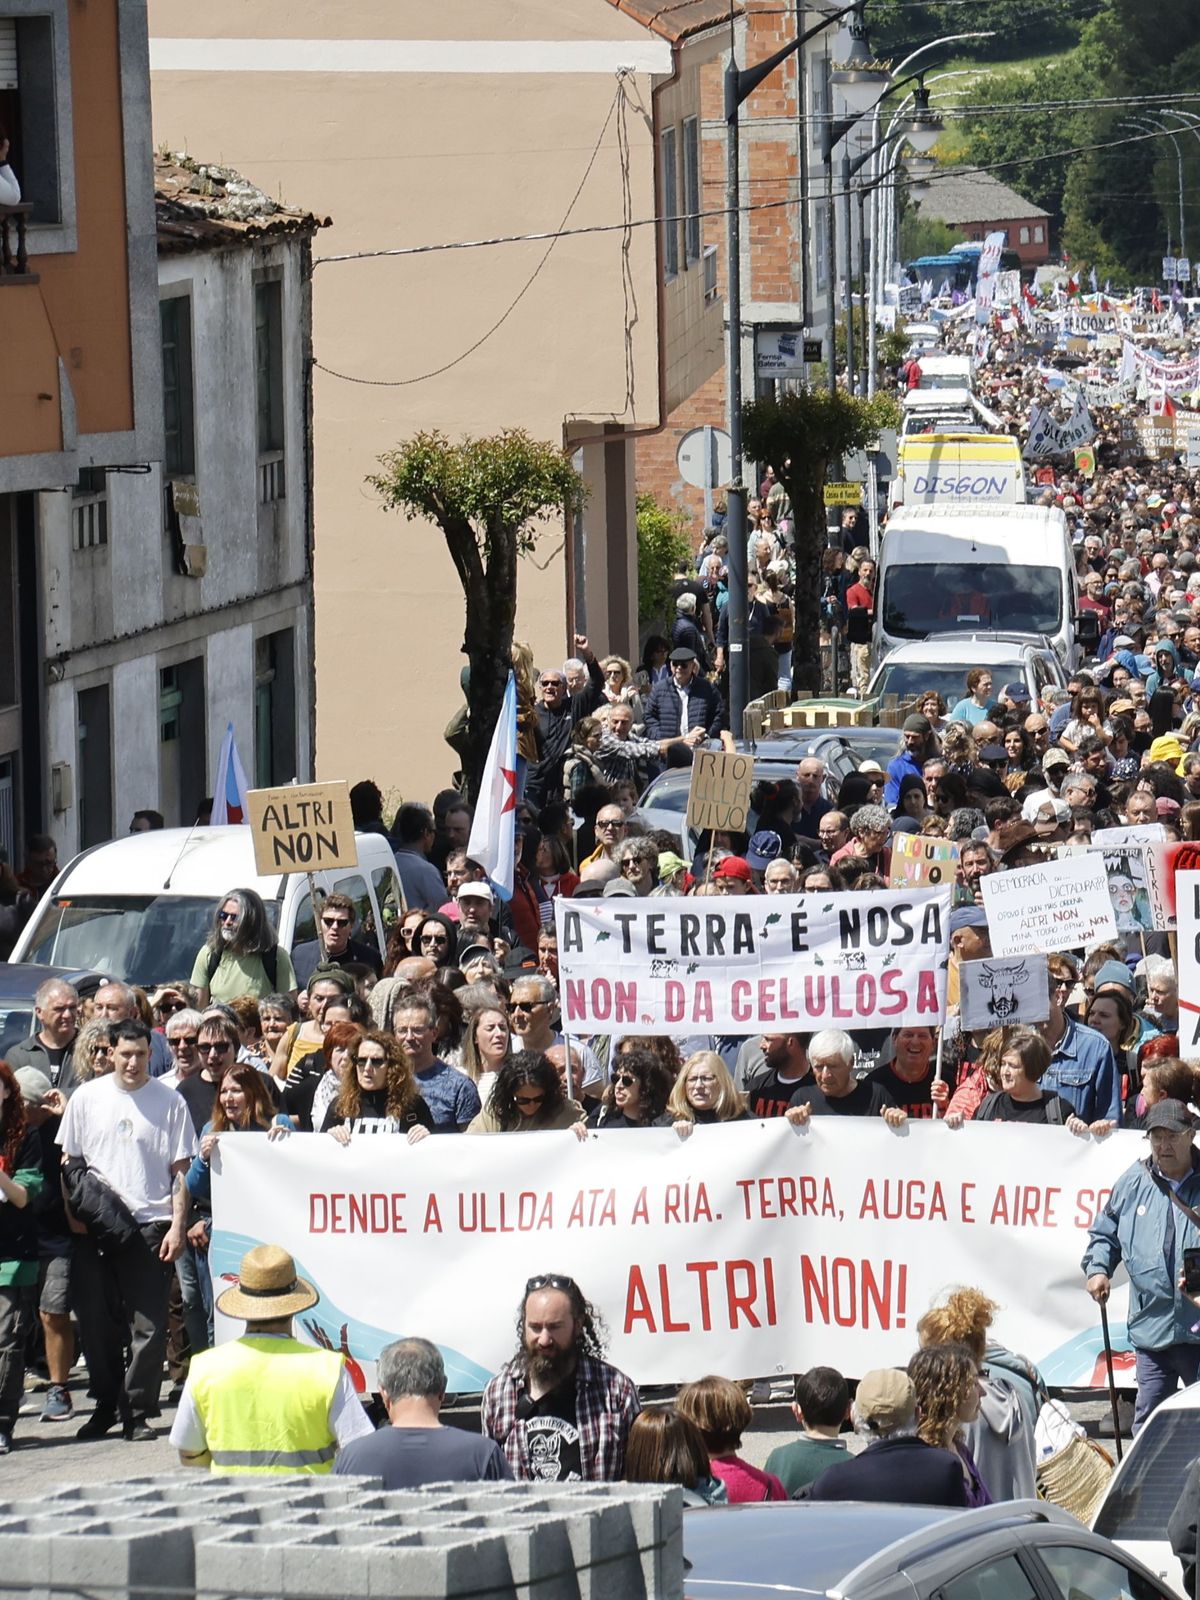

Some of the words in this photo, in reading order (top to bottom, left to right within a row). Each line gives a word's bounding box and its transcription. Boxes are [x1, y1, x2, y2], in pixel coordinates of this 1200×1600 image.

[913, 476, 1007, 495] DISGON
[700, 753, 747, 780] RIO
[694, 776, 748, 804] ULLA
[262, 800, 333, 832] ALTRI
[691, 803, 745, 829] VIVO
[273, 830, 339, 866] NON
[897, 835, 922, 858] RIO
[904, 862, 942, 885] VIVO
[990, 873, 1047, 895] DEMOCRACIA
[563, 911, 584, 953] A
[613, 911, 755, 957] TERRA
[838, 902, 943, 951] NOSA
[1020, 914, 1048, 929] ALTRI
[1053, 908, 1079, 922] NON
[1089, 914, 1110, 926] NON
[1078, 929, 1095, 942] NON
[665, 979, 714, 1024] DA
[730, 967, 939, 1022] CELULOSA
[309, 1193, 408, 1234] DENDE
[423, 1192, 443, 1233] A
[458, 1191, 554, 1233] ULLOA
[569, 1188, 617, 1230] ATA
[631, 1185, 650, 1226] A
[664, 1176, 723, 1226] RÍA.
[736, 1176, 845, 1222] TERRA,
[858, 1177, 948, 1221] AUGA
[960, 1182, 976, 1223] E
[990, 1183, 1062, 1227] AIRE
[623, 1256, 777, 1334] ALTRI
[801, 1253, 908, 1329] NON!
